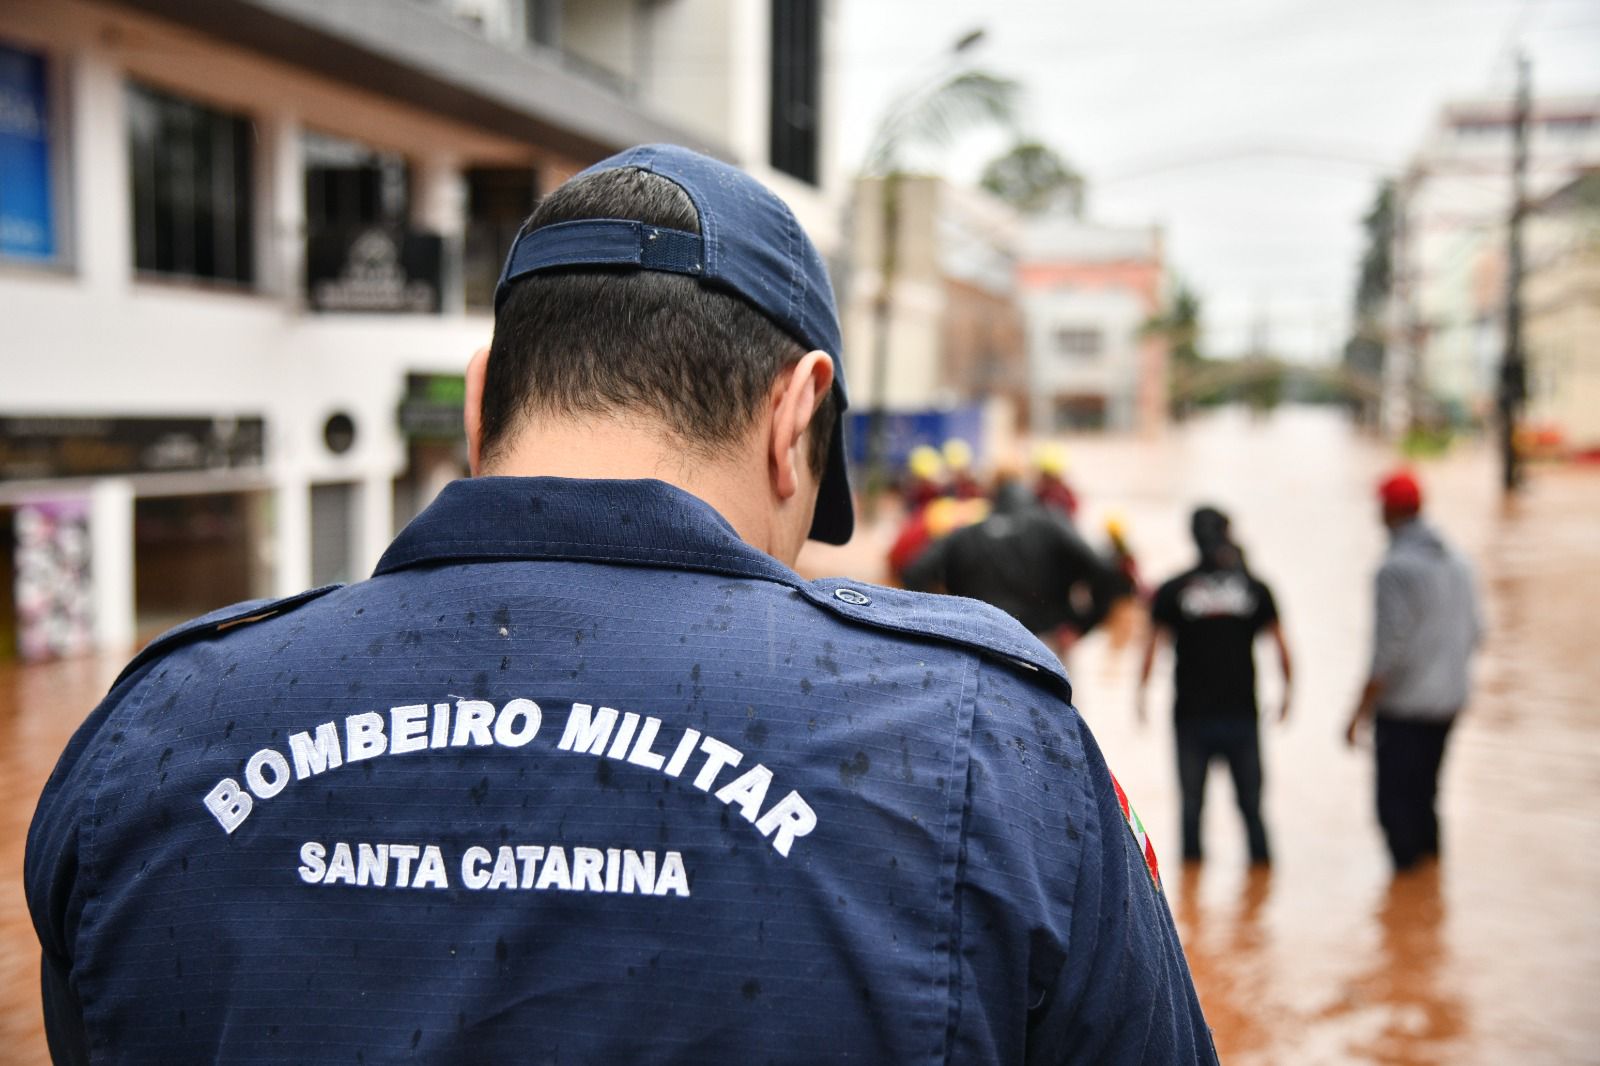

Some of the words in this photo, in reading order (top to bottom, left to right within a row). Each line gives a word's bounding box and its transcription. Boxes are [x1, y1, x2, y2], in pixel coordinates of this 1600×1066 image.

[202, 698, 543, 835] BOMBEIRO
[557, 702, 818, 858] MILITAR
[297, 842, 449, 889] SANTA
[461, 845, 691, 897] CATARINA
